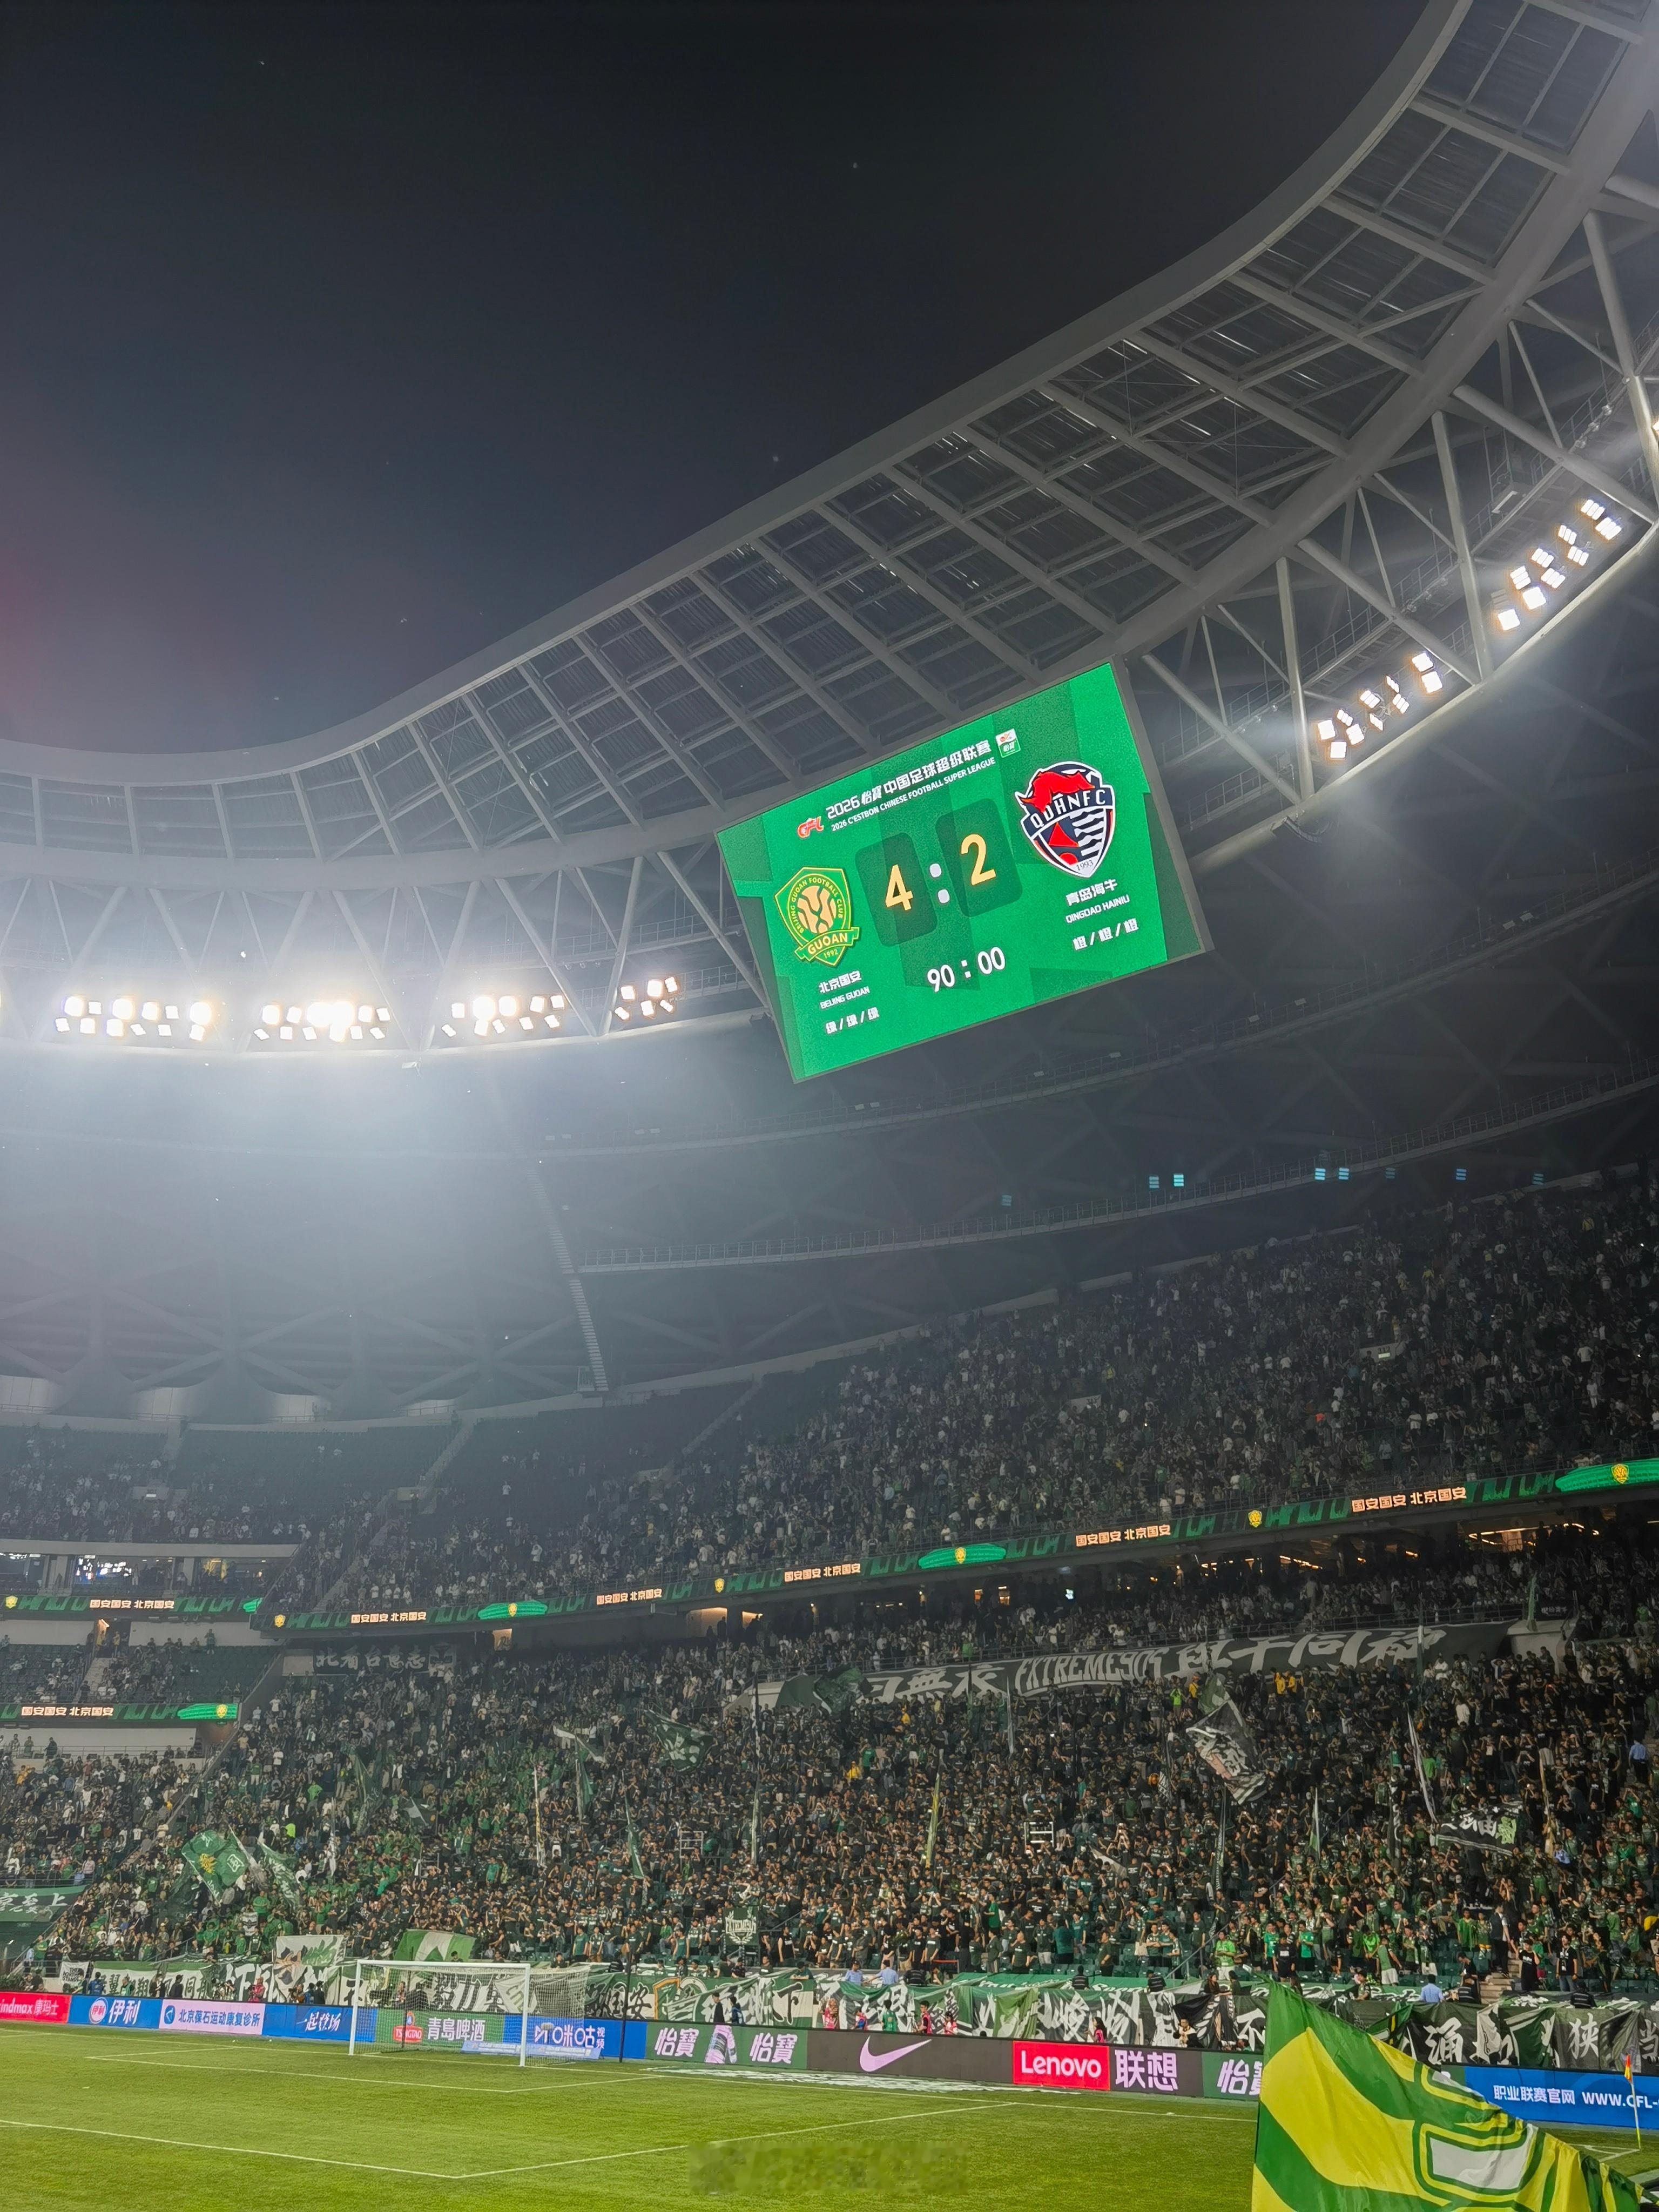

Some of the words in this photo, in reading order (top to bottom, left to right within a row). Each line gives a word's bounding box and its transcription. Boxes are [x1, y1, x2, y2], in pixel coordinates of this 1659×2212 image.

[826, 795, 860, 819] 2026
[884, 740, 992, 793] 中国足球超级联赛
[831, 820, 847, 832] 2026
[847, 806, 880, 825] C'ESTBON
[880, 794, 908, 811] CHINESE
[908, 779, 944, 799] FOOTBALL
[943, 769, 967, 784] SUPER
[967, 757, 996, 774] LEAGUE
[1030, 790, 1105, 829] QDHNFC
[885, 864, 913, 911] 4
[961, 834, 996, 886] 2
[1076, 860, 1094, 871] 1993
[792, 880, 807, 902] GUOAN
[809, 878, 839, 898] FOOTBALL
[1065, 879, 1117, 906] 青岛海牛
[791, 906, 804, 933] BEIJING
[1065, 905, 1102, 923] QINGDAO
[1102, 894, 1130, 911] HAINIU
[808, 933, 848, 954] GUOAN
[824, 949, 838, 959] 1992
[819, 970, 862, 993] 北京国安
[820, 995, 845, 1009] BEIJING
[846, 986, 870, 1000] GUOAN
[1352, 1494, 1406, 1512] 国安国安
[1410, 1487, 1466, 1505] 北京国安
[1076, 1530, 1121, 1546] 国安国安
[1124, 1524, 1170, 1540] 北京国安
[784, 1568, 821, 1582] 国安国安
[823, 1563, 860, 1576] 北京国安
[89, 1599, 131, 1609] 国安国安
[133, 1600, 174, 1609] 北京国安
[597, 1593, 628, 1604] 国安国安
[630, 1588, 662, 1600] 北京国安
[351, 1613, 388, 1623] 国安国安
[390, 1611, 426, 1622] 北京国安
[21, 1707, 66, 1716] 国安国安
[69, 1707, 113, 1716] 北京国安
[0, 1997, 33, 2014] indmax
[108, 1999, 141, 2025] 伊利
[178, 2008, 261, 2027] 北京葆石运动康复诊所
[395, 2028, 422, 2039] TSNGTAO
[655, 2026, 699, 2058] 怡寶
[749, 2032, 798, 2064] 怡寶
[1021, 2050, 1102, 2079] Lenovo
[1115, 2049, 1178, 2092] 联想
[1493, 2085, 1576, 2105] 职业联赛官网
